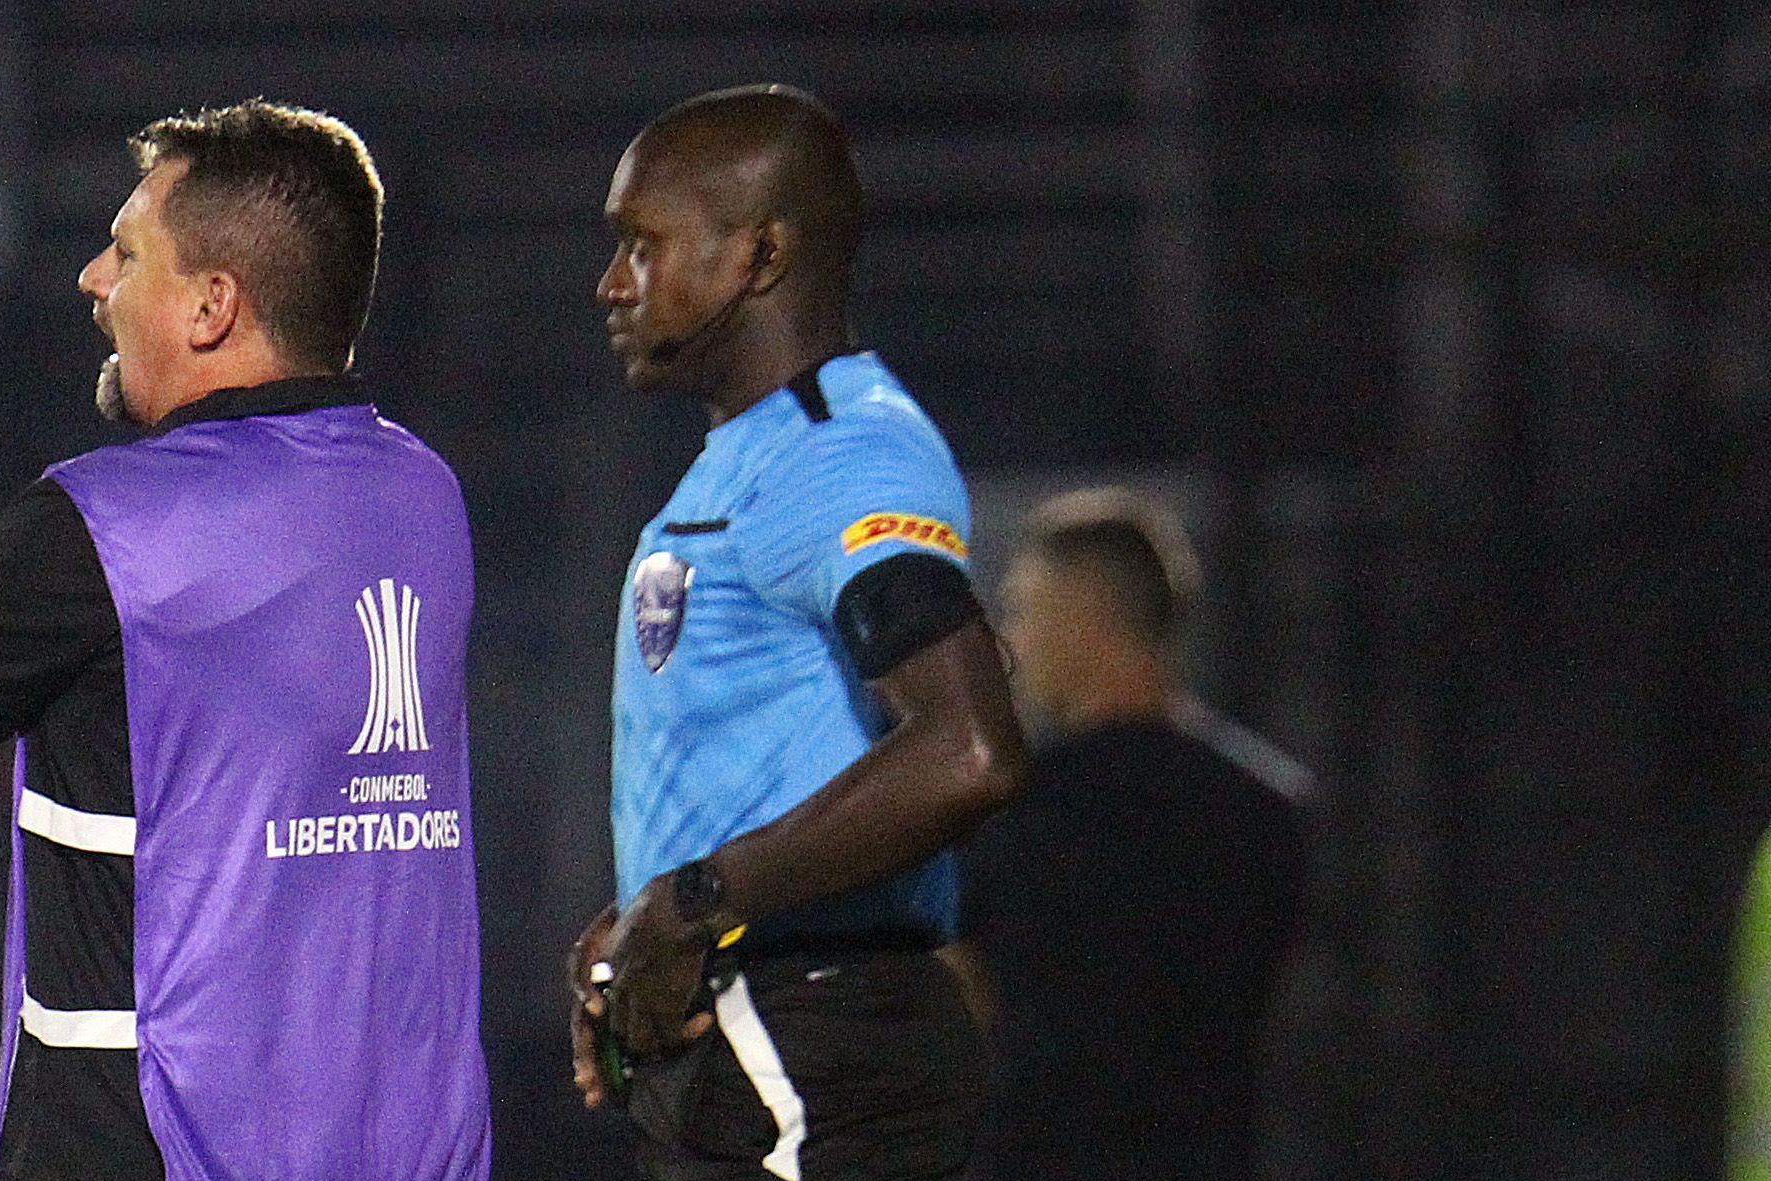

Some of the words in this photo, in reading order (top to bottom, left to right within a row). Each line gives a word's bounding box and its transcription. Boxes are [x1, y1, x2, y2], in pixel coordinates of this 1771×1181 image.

[861, 517, 957, 550] DHL
[349, 774, 428, 803] CONMEBOL
[265, 810, 461, 858] LIBERTADORES
